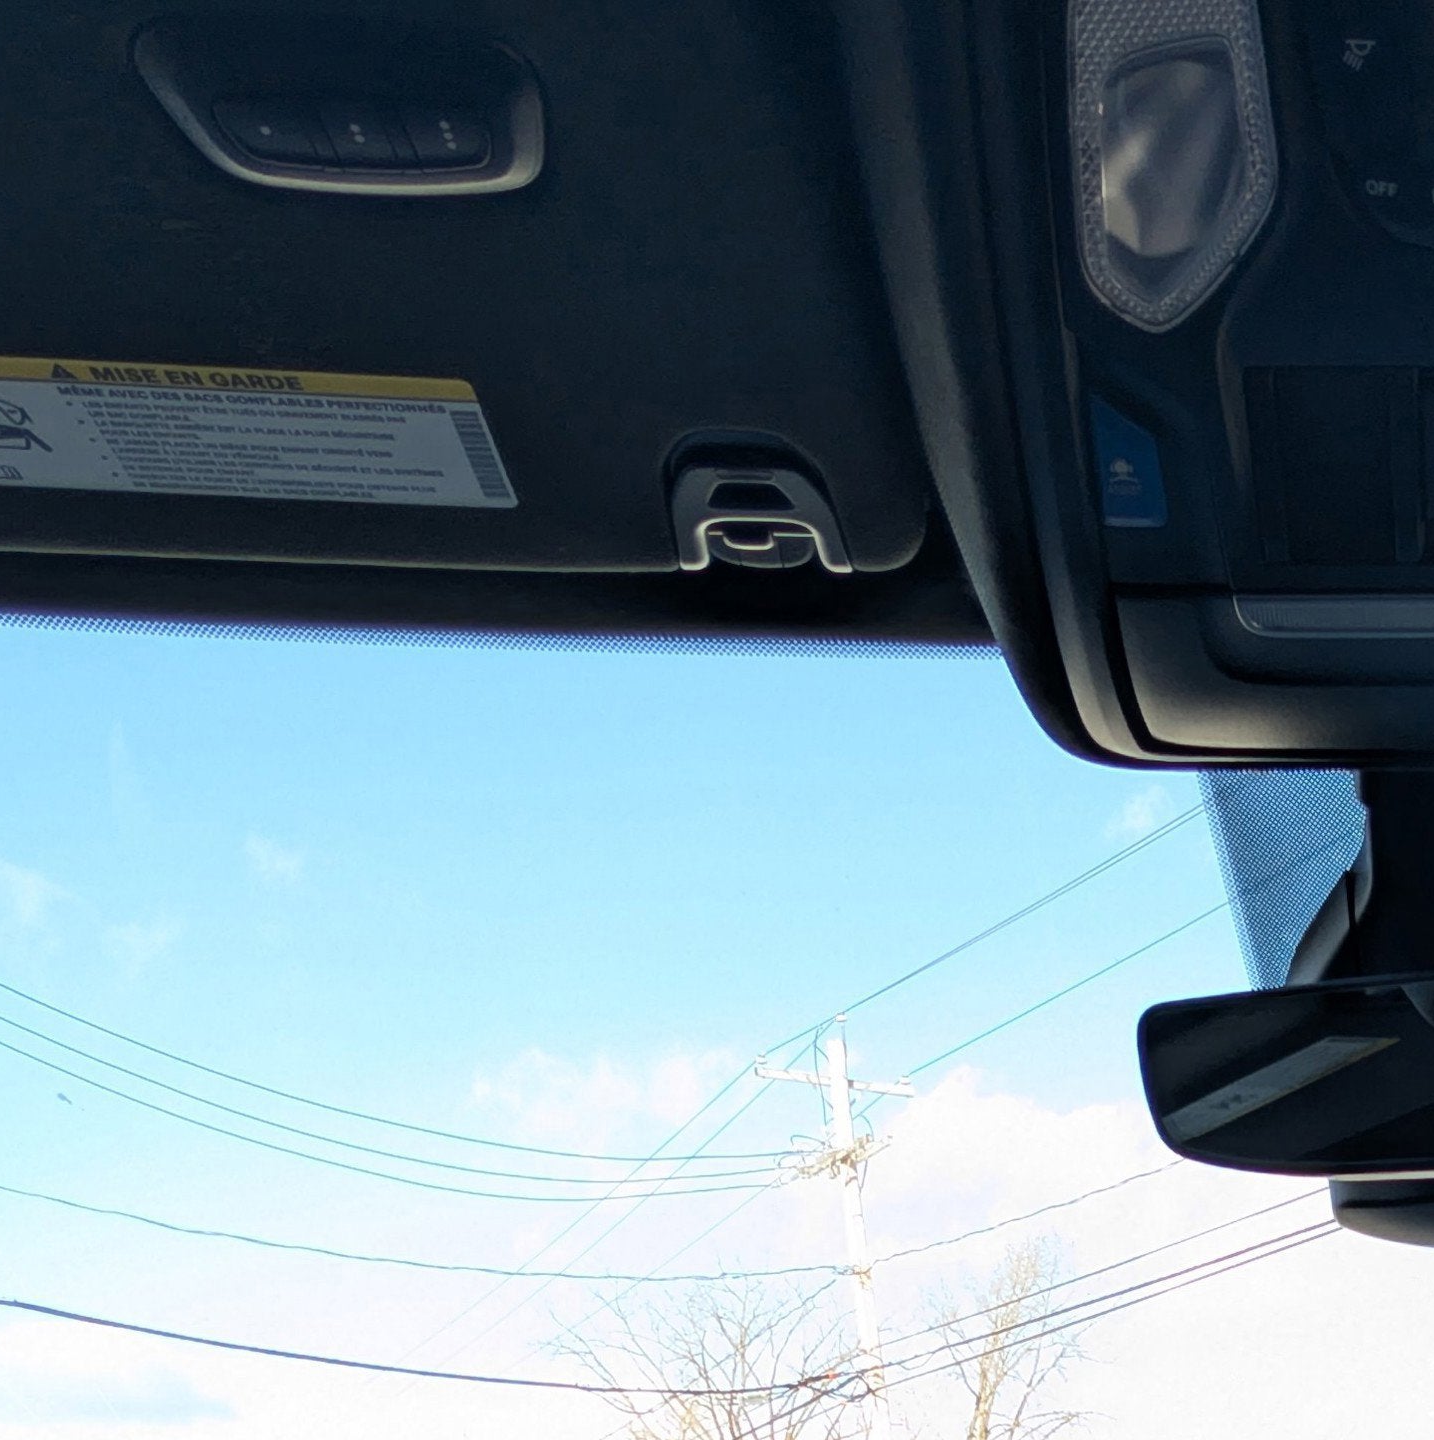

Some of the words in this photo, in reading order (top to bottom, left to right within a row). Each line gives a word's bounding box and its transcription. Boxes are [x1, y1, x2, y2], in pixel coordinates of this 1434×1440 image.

[1365, 179, 1399, 197] OFF
[89, 366, 157, 385] MISE
[164, 370, 205, 387] EN
[209, 372, 304, 391] GARDE
[109, 389, 149, 400] AVEC
[150, 391, 182, 402] DES
[184, 392, 224, 404] SACS
